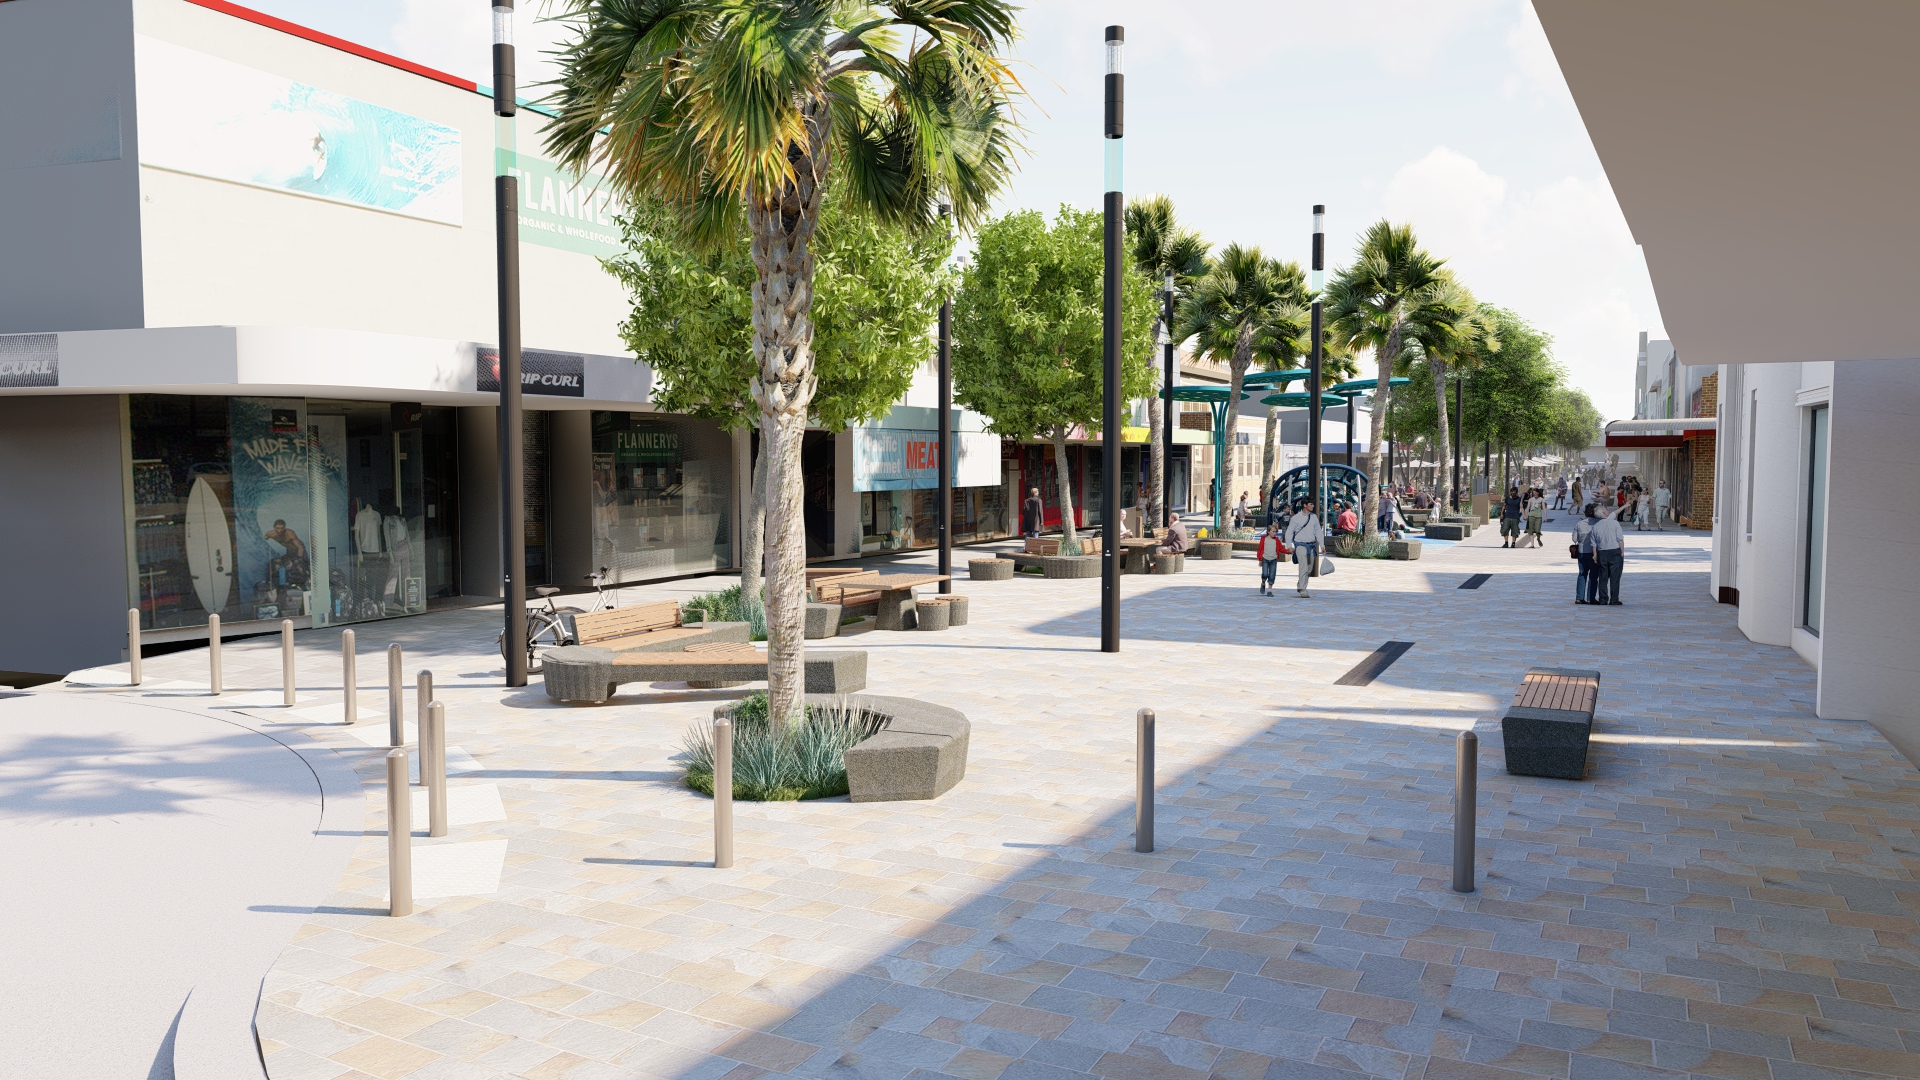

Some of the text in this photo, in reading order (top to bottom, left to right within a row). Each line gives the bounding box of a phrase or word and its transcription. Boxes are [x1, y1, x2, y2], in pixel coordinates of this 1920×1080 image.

[557, 224, 564, 235] &
[565, 225, 616, 246] WHOLEFOOD
[541, 374, 580, 387] CURL
[243, 438, 291, 460] MADE
[617, 431, 679, 449] FLANNERYS
[866, 435, 898, 453] Pacific
[595, 463, 601, 471] by
[864, 458, 901, 475] Gourmet
